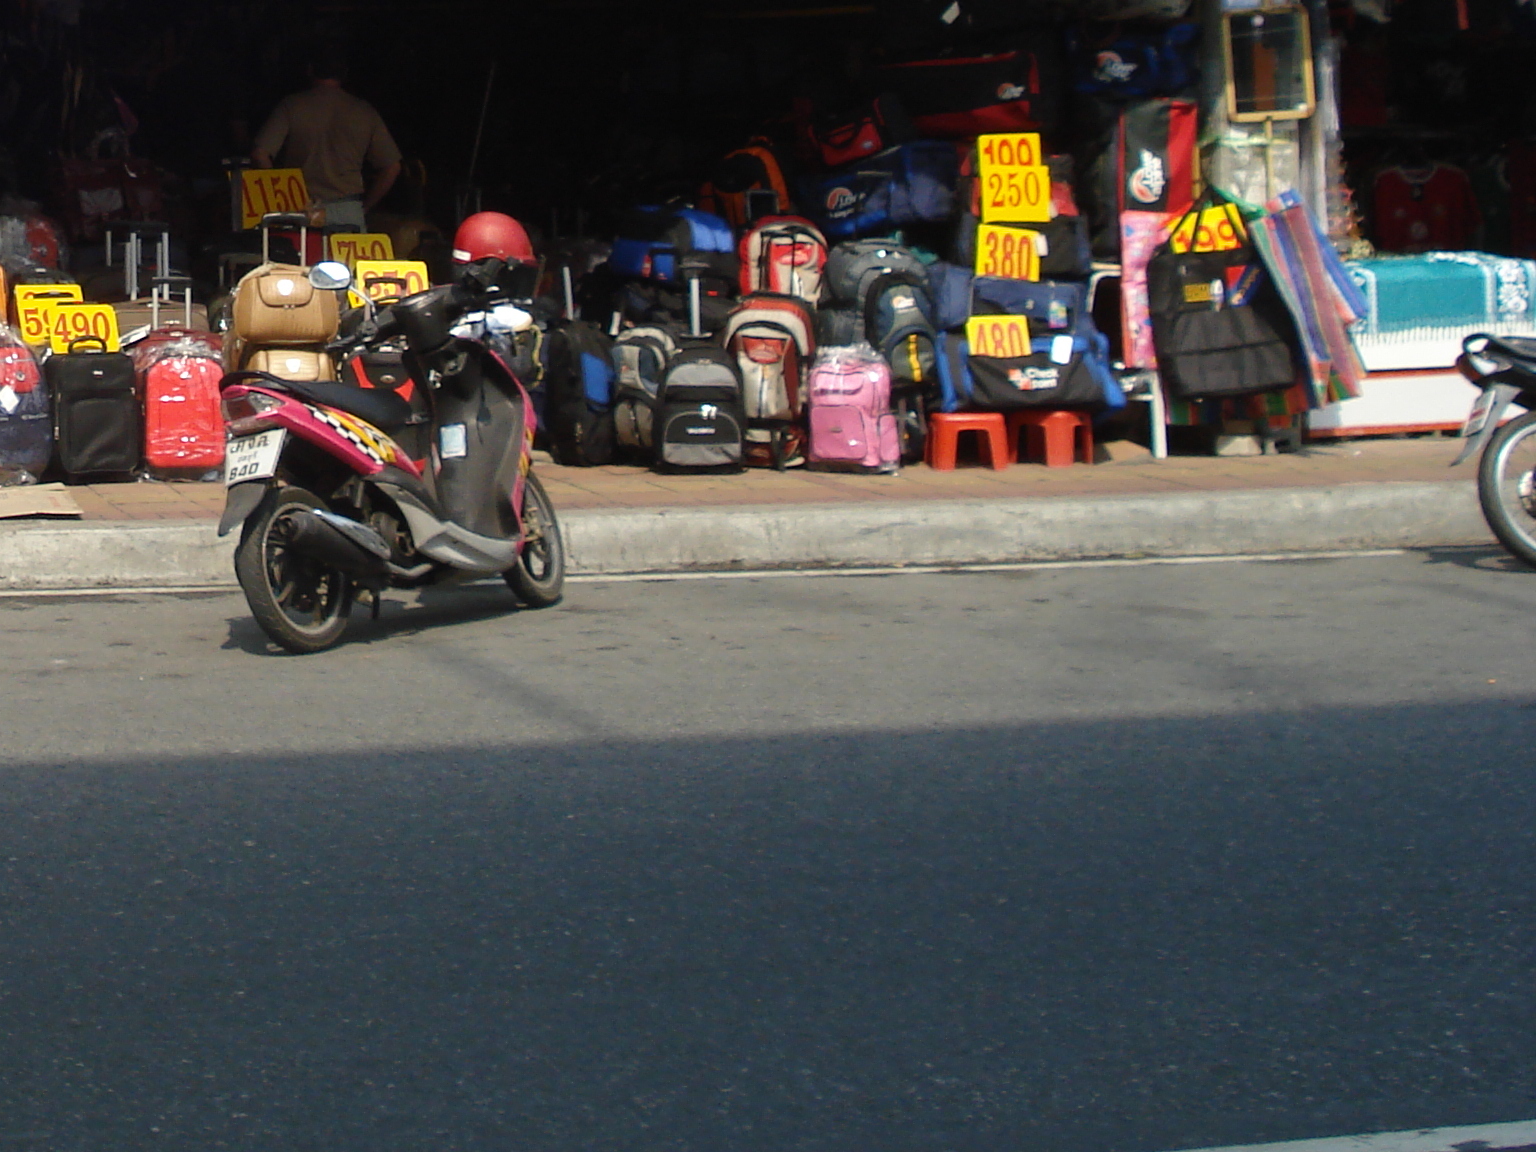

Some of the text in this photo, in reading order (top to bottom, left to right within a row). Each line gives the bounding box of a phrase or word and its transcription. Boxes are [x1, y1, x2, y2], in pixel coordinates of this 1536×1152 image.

[241, 175, 307, 218] 1150
[989, 171, 1041, 208] 250
[984, 231, 1032, 281] 380
[54, 312, 111, 344] 490
